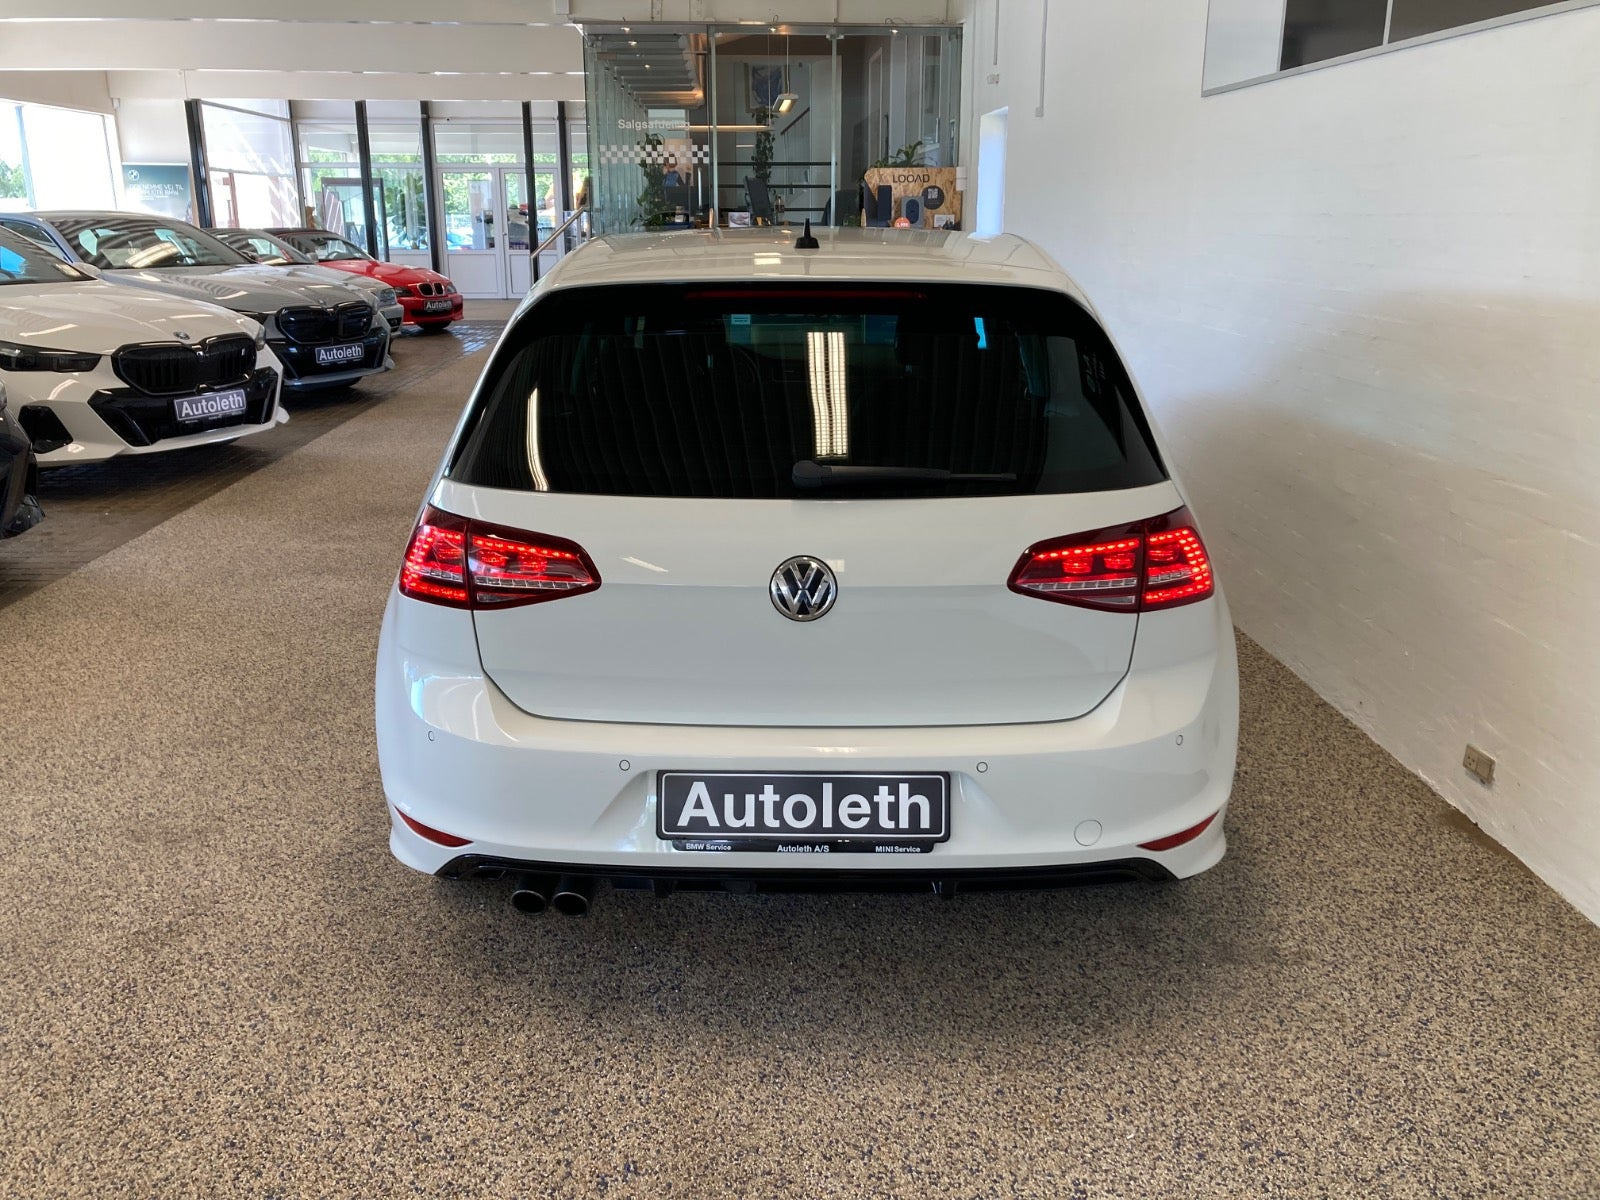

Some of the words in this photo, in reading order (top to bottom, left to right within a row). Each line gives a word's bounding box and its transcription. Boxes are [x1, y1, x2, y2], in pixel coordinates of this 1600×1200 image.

[319, 345, 362, 361] Autoleth
[181, 393, 243, 417] Autoleth
[677, 781, 931, 829] Autoleth
[777, 844, 812, 853] Autoleth
[814, 845, 830, 853] A/S
[875, 845, 894, 853] MINI
